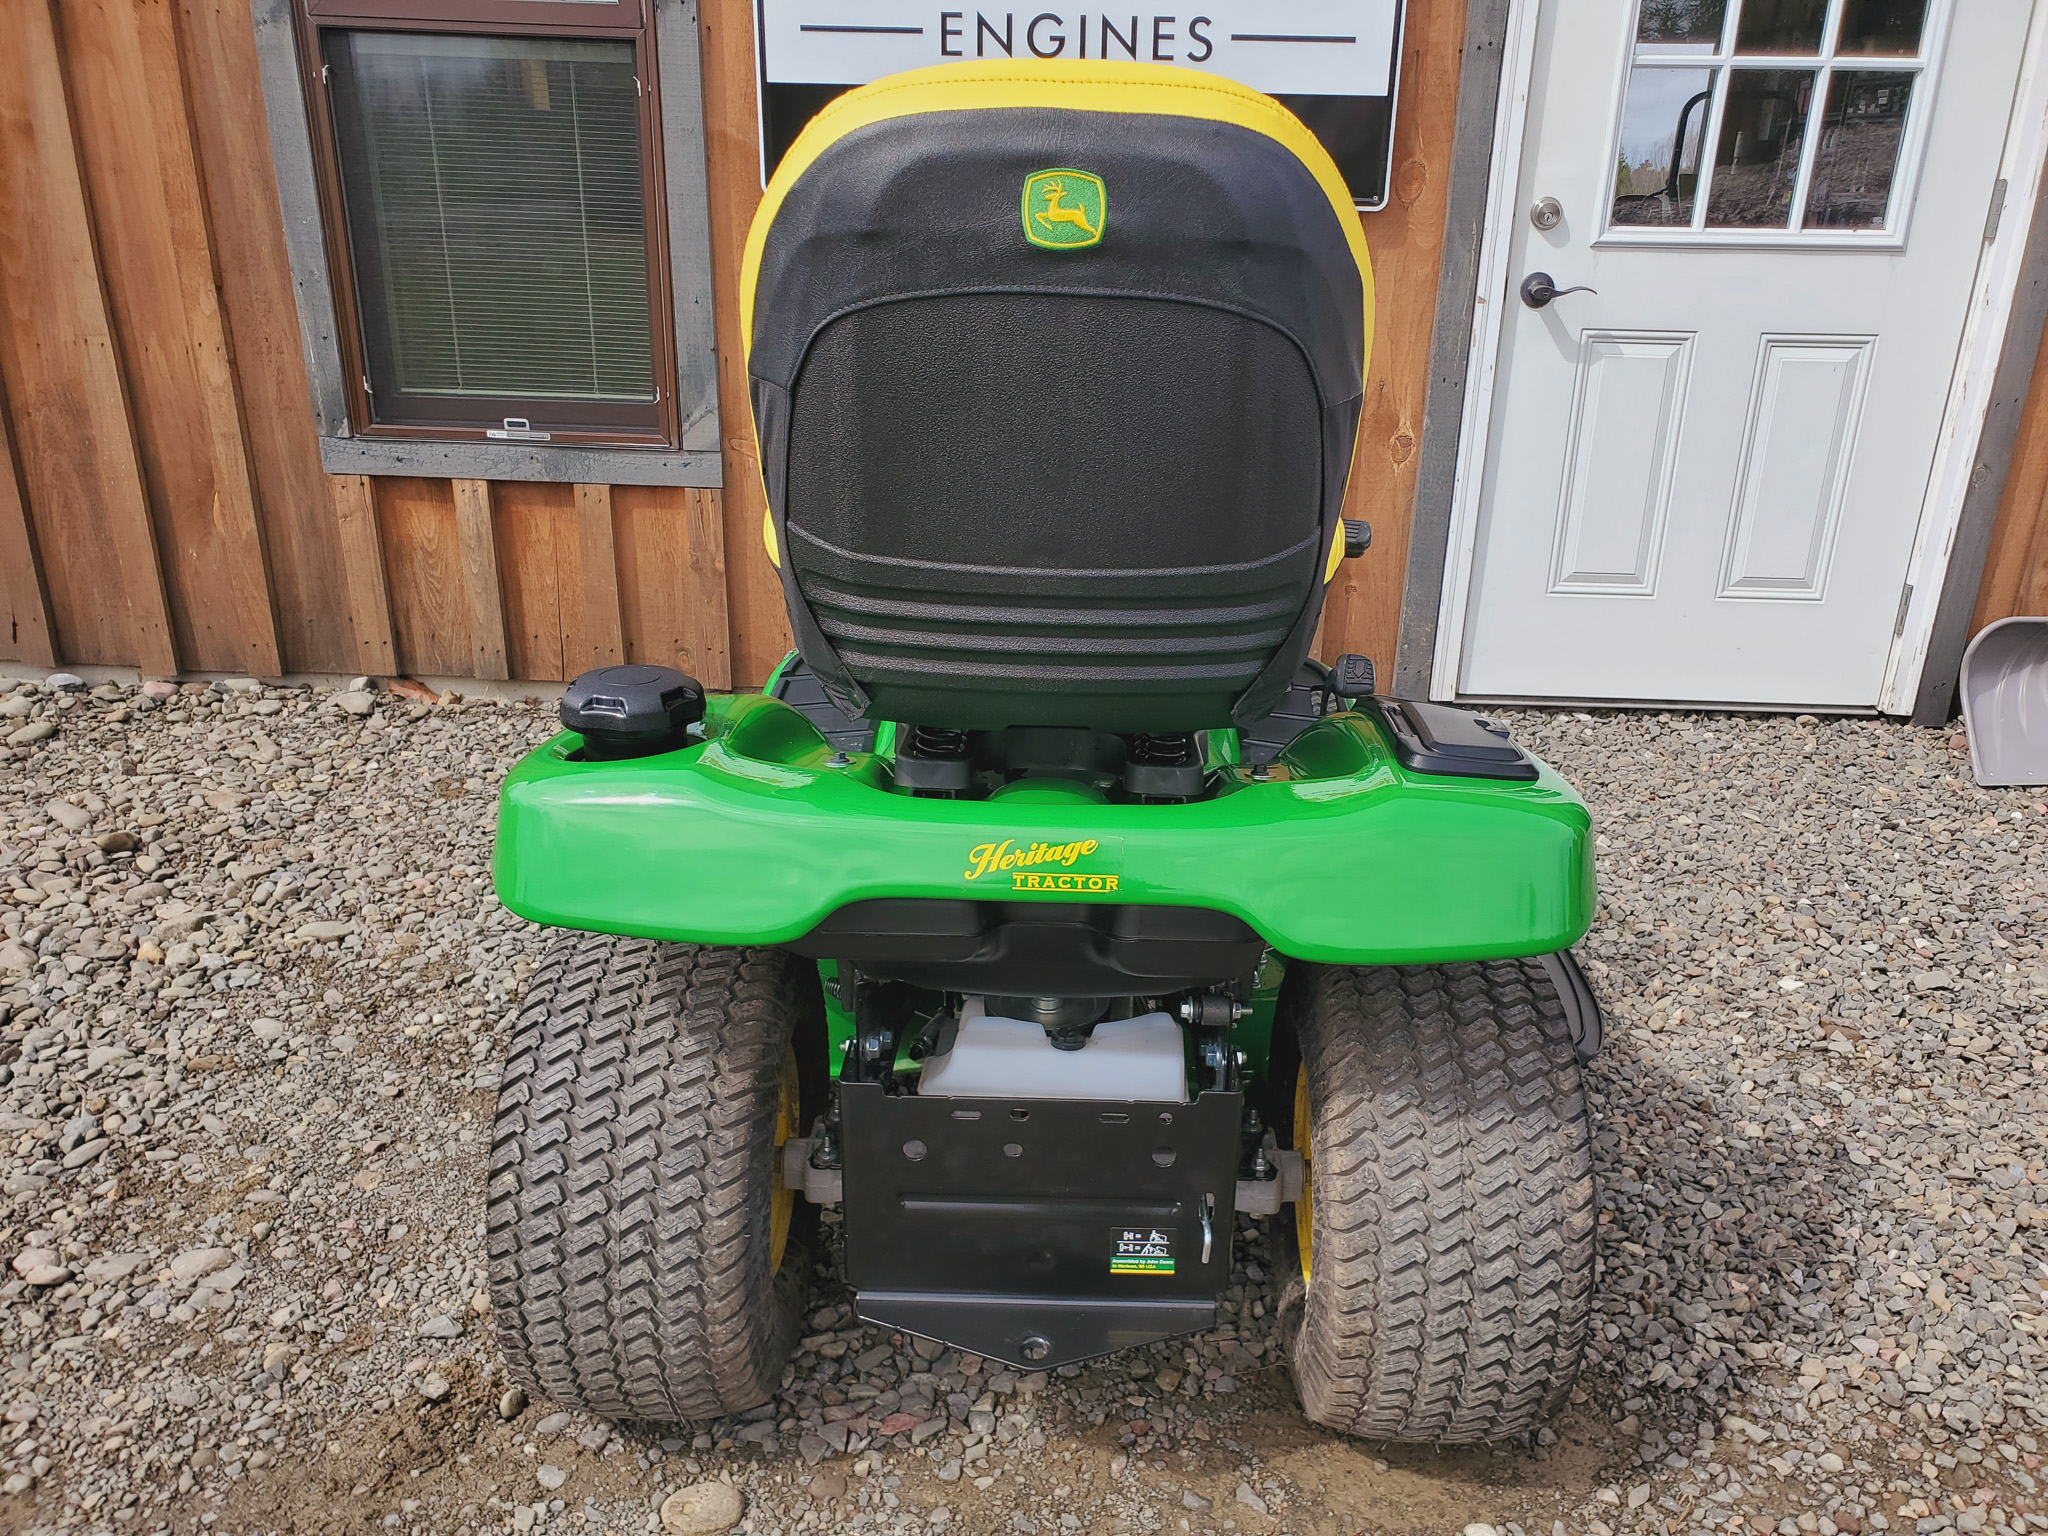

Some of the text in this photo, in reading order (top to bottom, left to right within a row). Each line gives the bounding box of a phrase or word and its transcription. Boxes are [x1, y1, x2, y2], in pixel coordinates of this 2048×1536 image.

[940, 9, 1214, 63] ENGINES
[964, 838, 1099, 881] Heritage
[1013, 874, 1119, 891] TRACTOR
